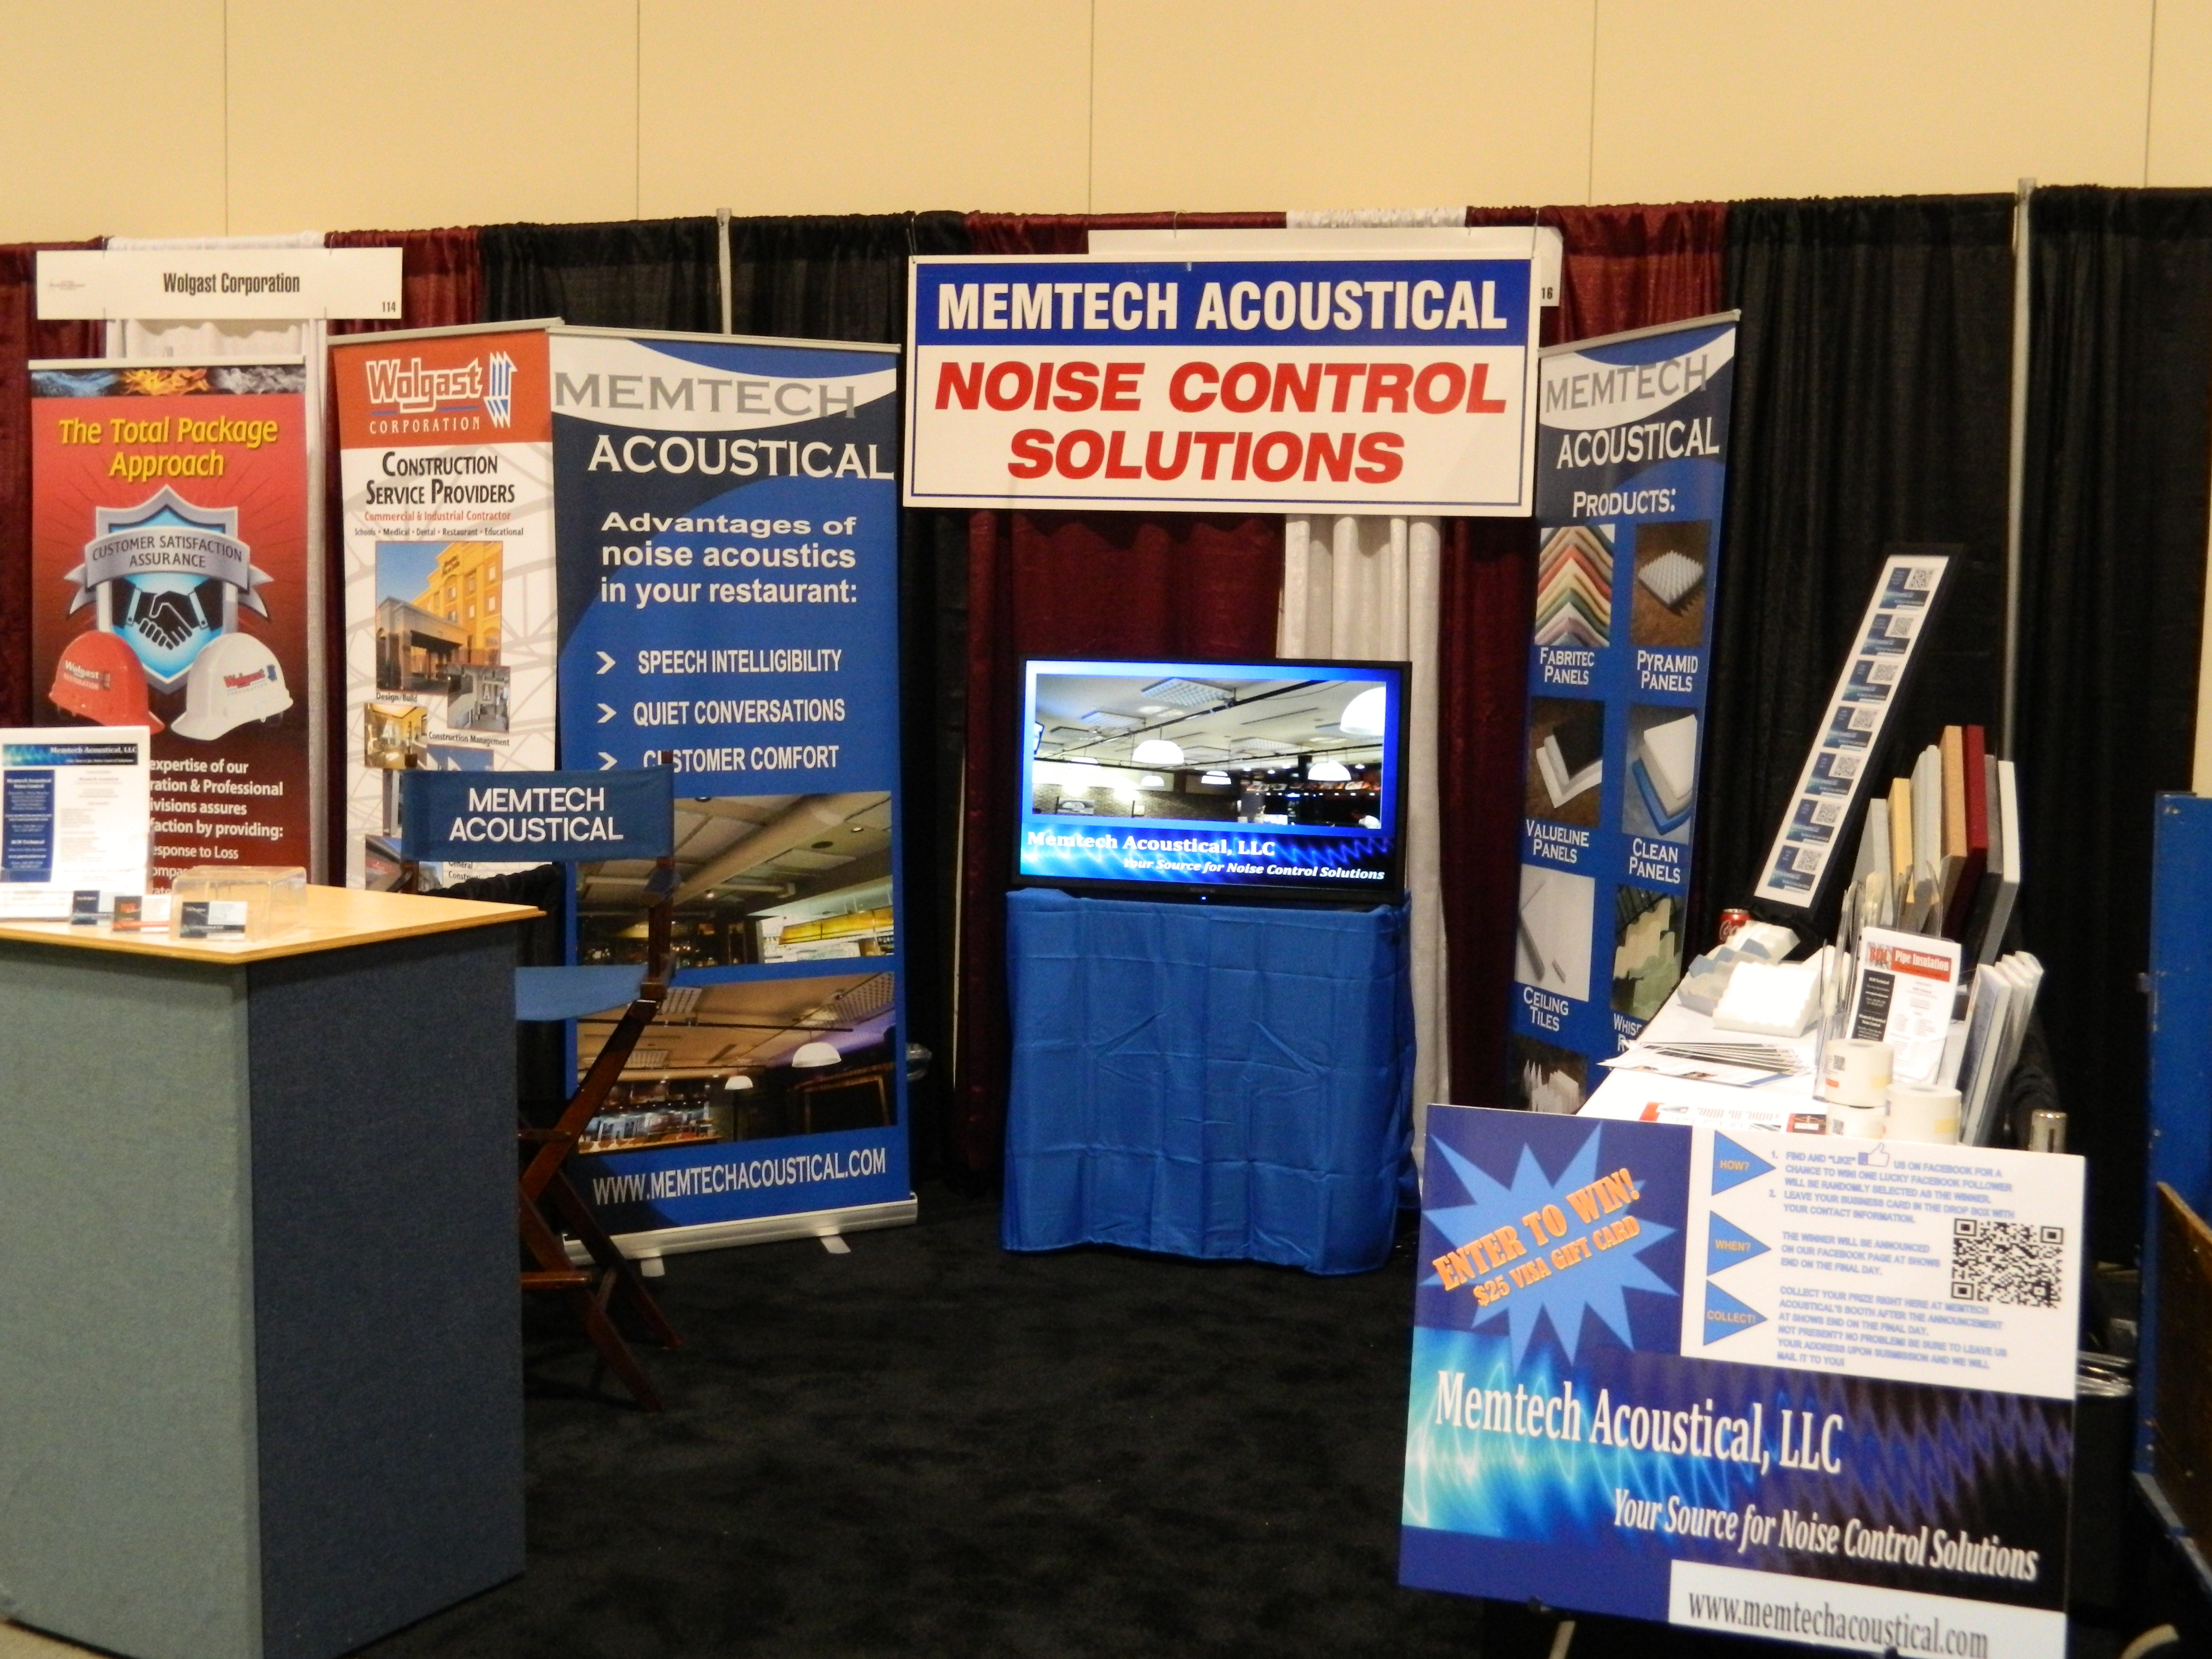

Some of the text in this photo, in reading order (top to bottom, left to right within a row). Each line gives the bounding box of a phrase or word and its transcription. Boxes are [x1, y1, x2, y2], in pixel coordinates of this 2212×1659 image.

[164, 273, 300, 295] Wolgast Corporation
[382, 302, 396, 312] 114
[938, 280, 1507, 330] MEMTECH ACOUSTICAL
[366, 357, 483, 414] Wolgast
[554, 372, 856, 418] MEMTECH
[934, 361, 1506, 415] NOISE CONTROL
[1546, 354, 1707, 413] MEMTECH
[59, 415, 278, 450] The Total Package
[370, 417, 480, 434] CORPORATION
[1557, 417, 1719, 469] ACOUSTICAL
[109, 450, 223, 482] Approach
[587, 434, 895, 480] ACOUSTICAL
[1007, 429, 1405, 484] SOLUTIONS
[1573, 488, 1676, 518] PRODUCTS:
[365, 511, 511, 521] Commercial & Industrial Contractor
[601, 513, 857, 539] Advantages of
[485, 528, 523, 536] Educational
[93, 536, 242, 562] CUSTOMER SATISFACTION
[129, 553, 206, 568] ASSURANCE
[602, 542, 856, 568] noise acoustics
[601, 577, 857, 609] in your restaurant:
[638, 649, 842, 674] SPEECH INTELLIGIBILITY
[1540, 648, 1594, 667] FABRITEC
[1637, 650, 1698, 674] PYRAMID
[1544, 666, 1589, 686] PANELS
[1641, 671, 1693, 692] PANELS
[376, 692, 417, 703] Design/Build
[634, 698, 845, 727] QUIET CONVERSATIONS
[429, 732, 509, 747] Construction Management
[210, 759, 224, 773] of
[227, 762, 249, 774] our
[751, 746, 839, 770] COMFORT
[190, 781, 200, 793] &
[203, 781, 283, 796] Professional
[469, 788, 604, 813] MEMTECH
[200, 803, 247, 816] assures
[197, 819, 212, 838] by
[216, 821, 284, 841] providing:
[450, 817, 623, 842] ACOUSTICAL
[1526, 819, 1590, 847] VALUELINE
[199, 847, 211, 859] to
[215, 846, 239, 859] Loss
[1027, 831, 1275, 856] Memtech Acoustical, LLC
[1533, 839, 1577, 863] PANELS
[1632, 838, 1678, 863] CLEAN
[1123, 858, 1385, 881] Your Source for Noise Control Solutions
[1629, 856, 1681, 884] PANELS
[1896, 950, 1911, 964] Pipe
[1913, 953, 1949, 972] Insulation
[1524, 987, 1569, 1016] CEILING
[1530, 1007, 1560, 1032] TILES
[593, 1147, 886, 1205] WWW.MEMTECHACOUSTICAL.COM
[1720, 1160, 1750, 1171] HOW?
[1771, 1150, 1778, 1159] 1.
[1786, 1150, 1805, 1161] FIND
[1808, 1152, 1825, 1163] AND
[1894, 1160, 1905, 1171] US
[1908, 1161, 1920, 1172] ON
[1923, 1163, 1972, 1177] FACEBOOK
[1975, 1168, 1992, 1179] FOR
[1995, 1169, 2002, 1180] A
[1769, 1187, 1776, 1198] 2.
[1784, 1189, 1812, 1201] LEAVE
[1815, 1192, 1838, 1204] YOUR
[1886, 1199, 1910, 1211] CARD
[1924, 1202, 1941, 1214] THE
[1944, 1204, 1968, 1216] DROP
[1971, 1207, 1989, 1218] BOX
[1992, 1209, 2014, 1221] WITH
[1783, 1202, 1807, 1214] YOUR
[1810, 1205, 1851, 1219] CONTACT
[1432, 1168, 1640, 1291] ENTER TO WIN!
[1716, 1240, 1751, 1251] WHEN?
[1781, 1244, 1794, 1254] ON
[1796, 1245, 1815, 1256] OUR
[1818, 1247, 1865, 1261] FACEBOOK
[1868, 1252, 1891, 1263] PAGE
[1894, 1254, 1905, 1265] AT
[1473, 1215, 1641, 1307] $25 VISA GIFT CARD
[1781, 1257, 1882, 1276] END ON THE FINAL DAY.
[1780, 1286, 1819, 1299] COLLECT
[1822, 1289, 1846, 1302] YOUR
[1848, 1292, 1873, 1304] PRIZE
[1876, 1294, 1902, 1307] RIGHT
[1905, 1298, 1929, 1309] HERE
[1931, 1300, 1943, 1311] AT
[1436, 1370, 1842, 1476] Memtech Acoustical, LLC
[1613, 1488, 2038, 1581] Your Source for Noise Control Solutions
[1688, 1589, 1989, 1659] www.memtechacoustical.com
